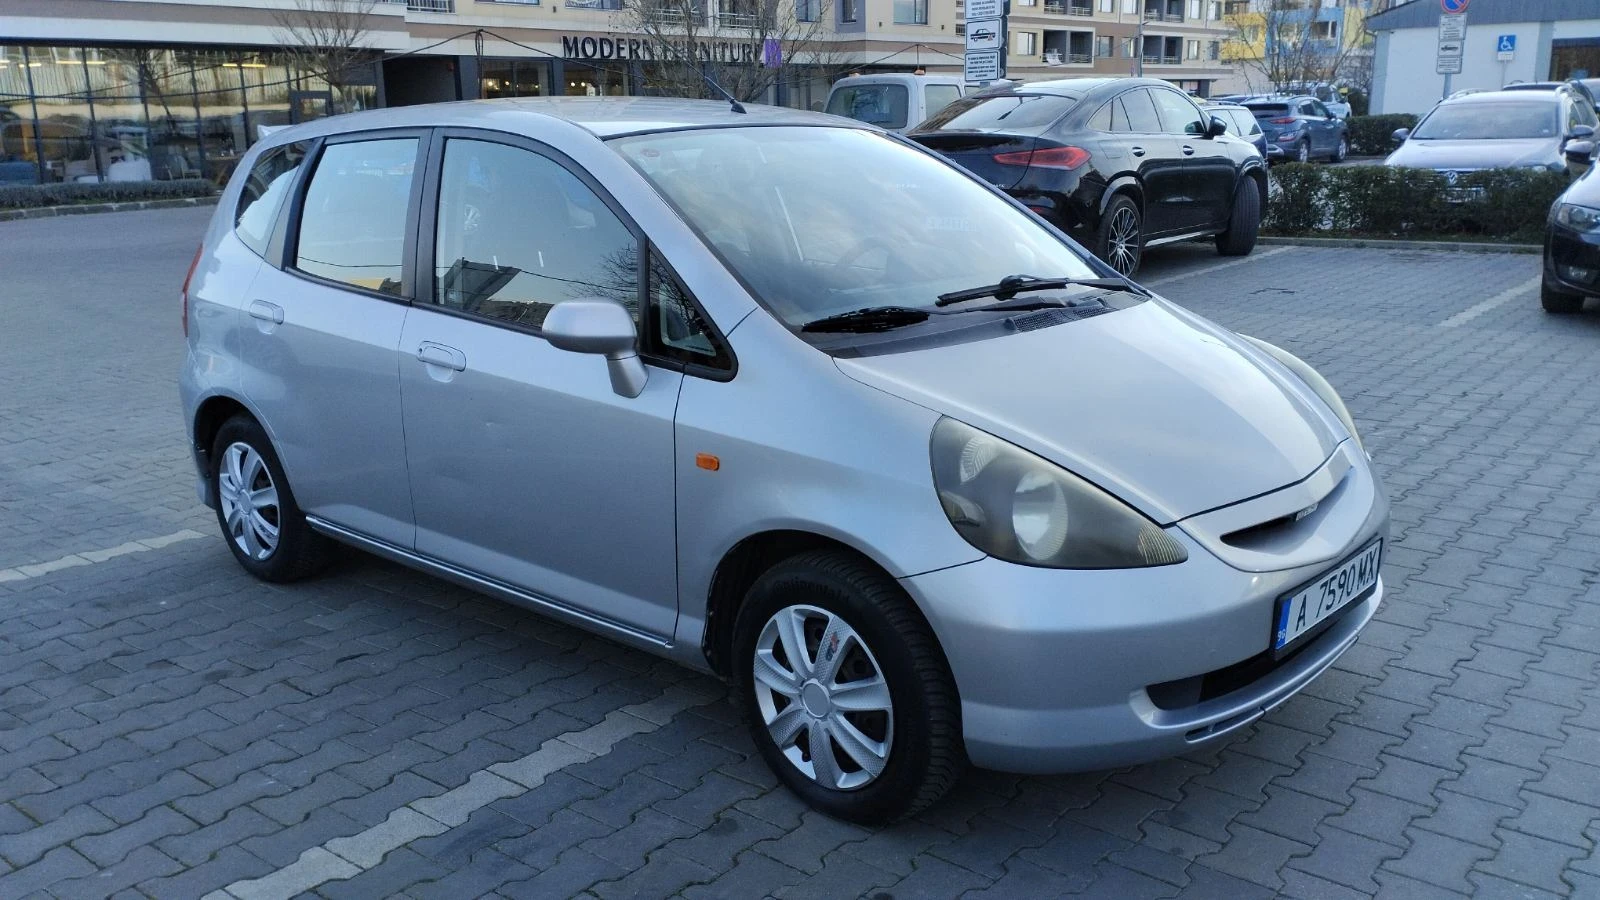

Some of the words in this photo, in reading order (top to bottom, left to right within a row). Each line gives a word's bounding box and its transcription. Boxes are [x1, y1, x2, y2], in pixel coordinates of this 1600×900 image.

[562, 36, 655, 59] MODERN
[661, 40, 763, 62] UNITUR
[1295, 594, 1307, 632] A
[1315, 563, 1356, 618] 7590
[1357, 547, 1378, 590] MX
